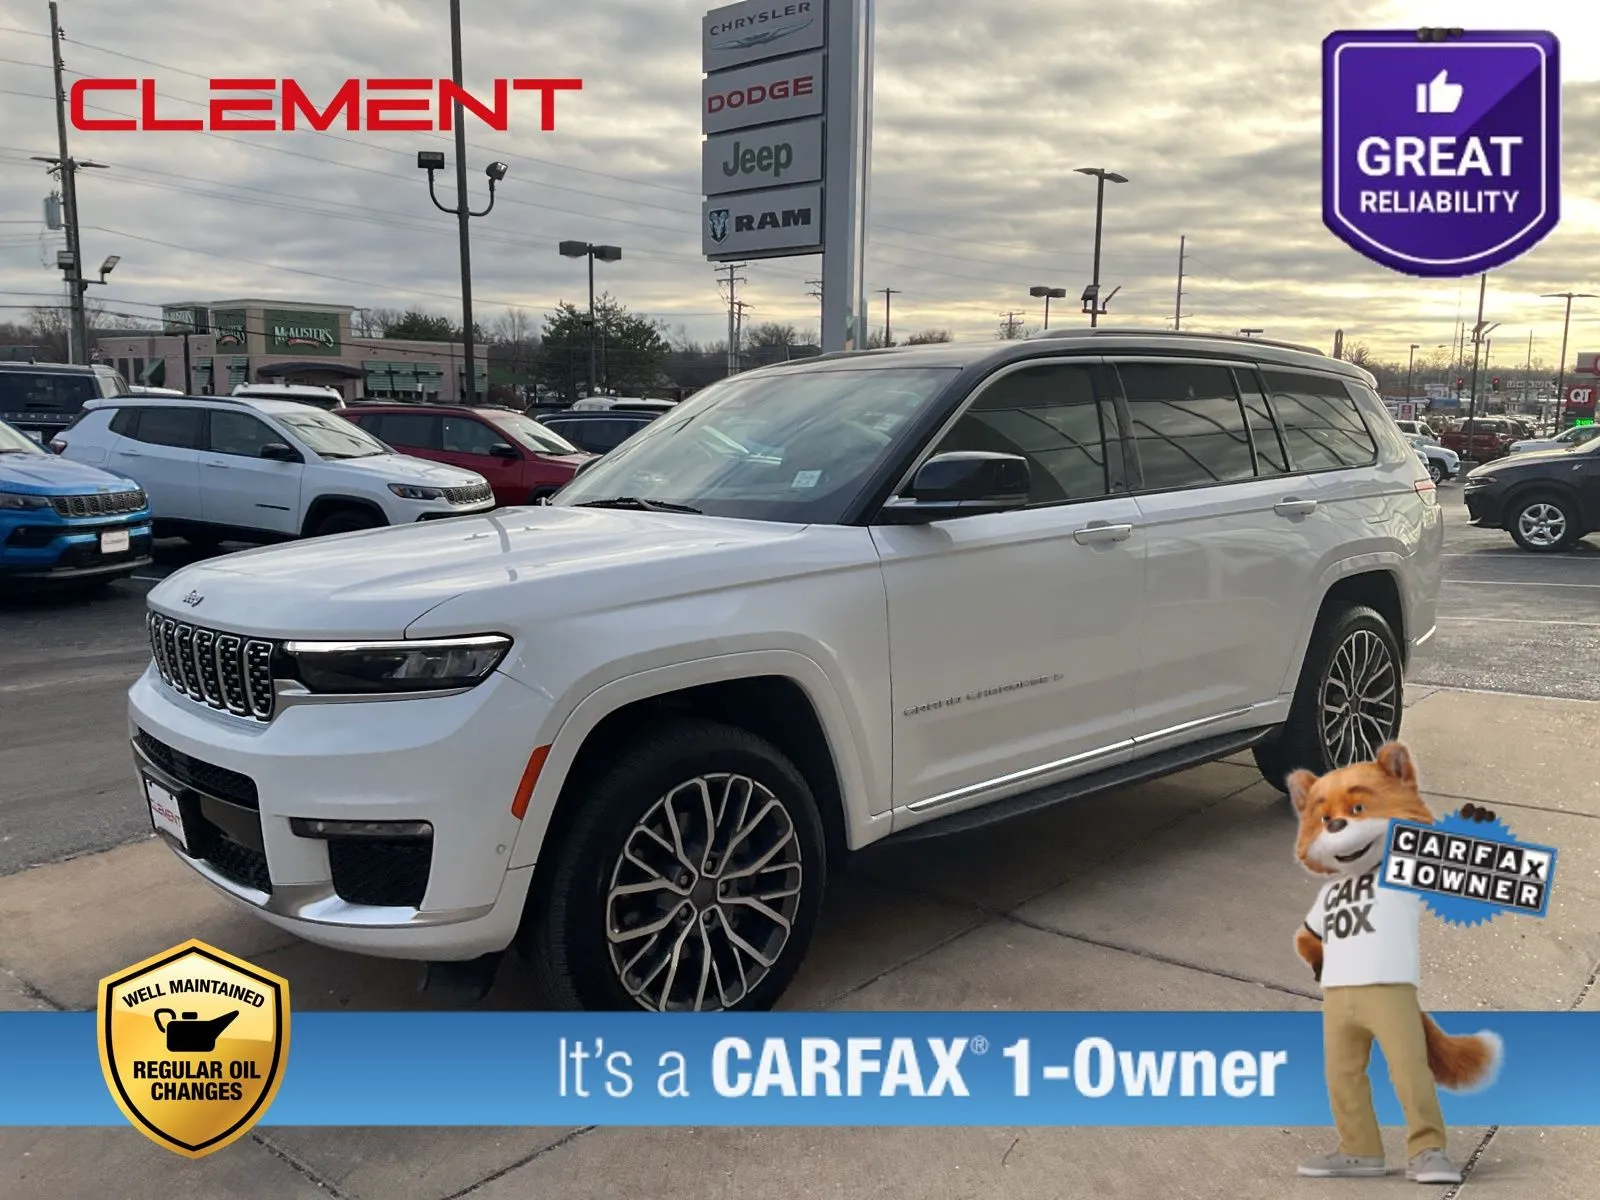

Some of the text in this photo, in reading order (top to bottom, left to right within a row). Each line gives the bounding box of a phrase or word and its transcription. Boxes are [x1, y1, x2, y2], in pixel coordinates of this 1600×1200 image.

[709, 2, 811, 36] CHRYSLER
[707, 76, 813, 114] DODGE
[722, 141, 793, 177] Jeep
[735, 208, 812, 233] RAM
[1570, 389, 1592, 403] QT
